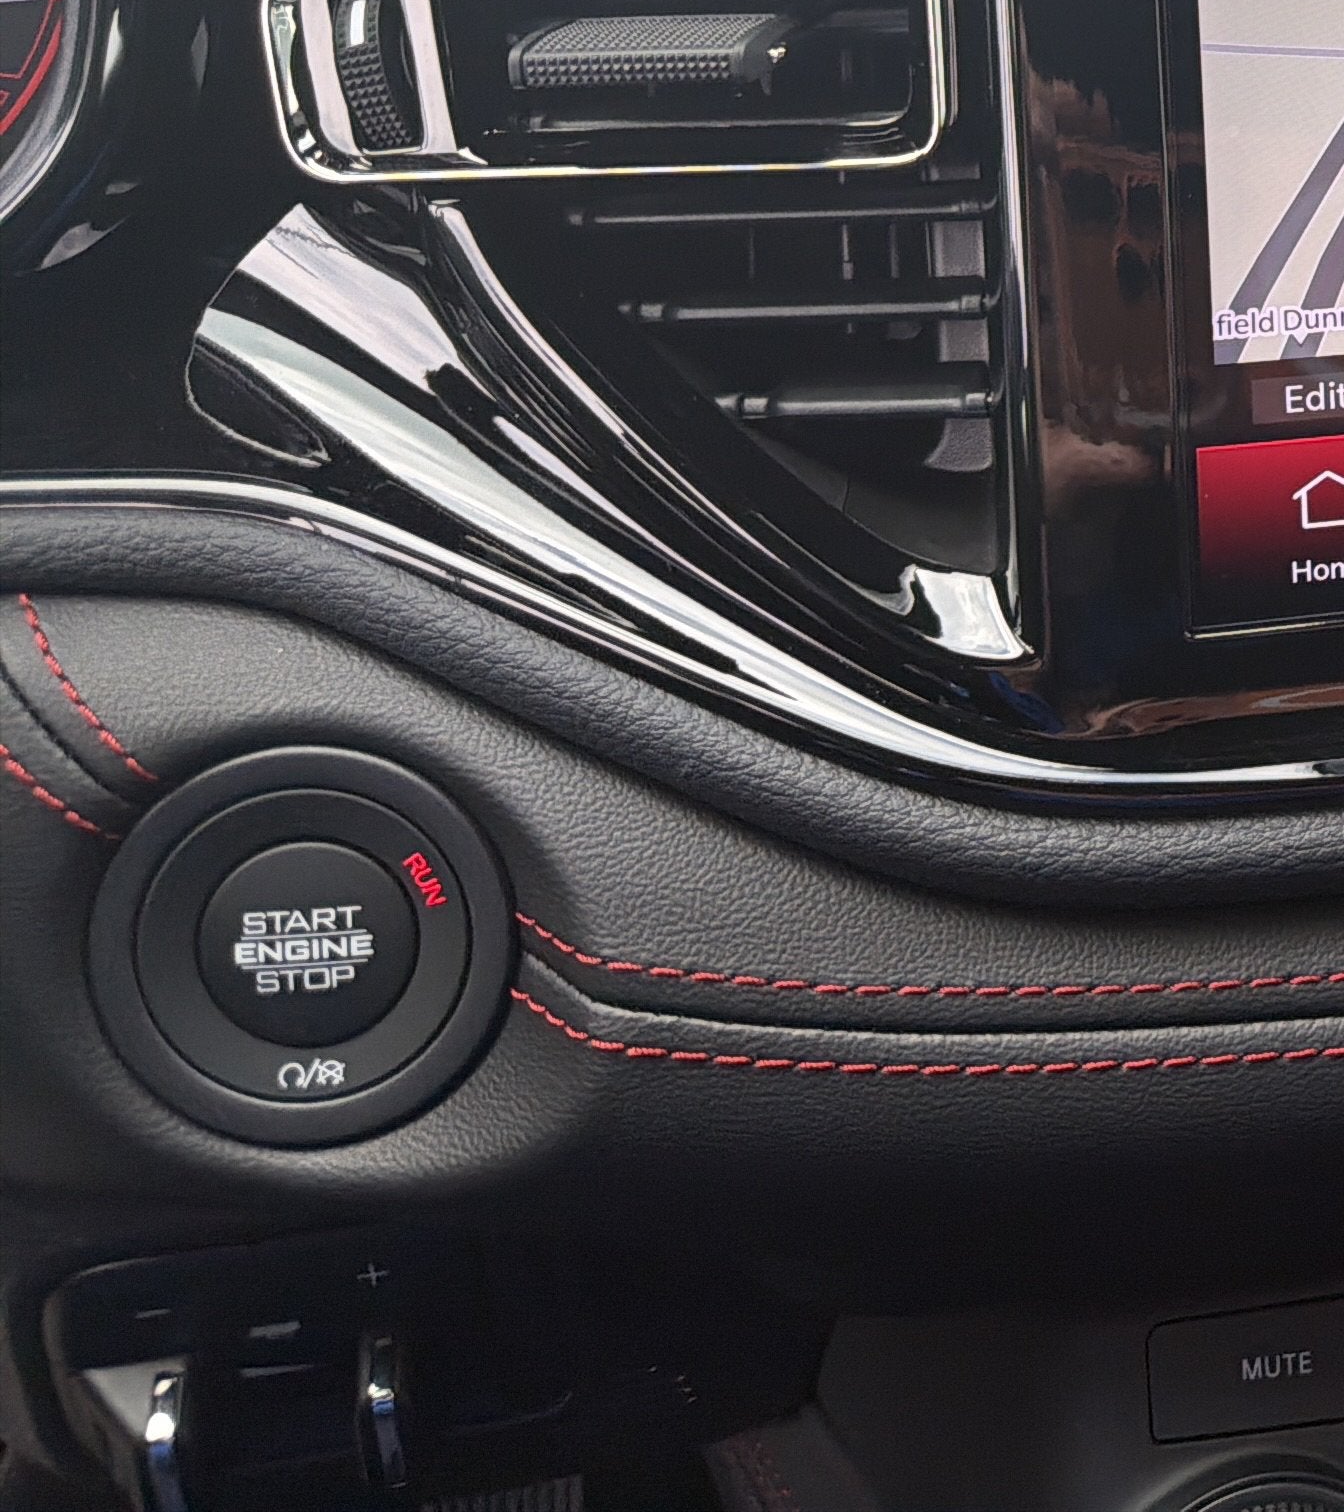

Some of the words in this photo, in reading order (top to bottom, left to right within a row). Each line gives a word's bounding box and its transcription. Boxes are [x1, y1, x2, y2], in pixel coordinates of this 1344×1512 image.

[1216, 310, 1274, 336] field
[402, 851, 449, 909] RUN
[242, 905, 363, 936] START
[234, 933, 375, 965] ENGINE
[255, 964, 356, 994] STOP
[1242, 1351, 1313, 1381] MUTE
